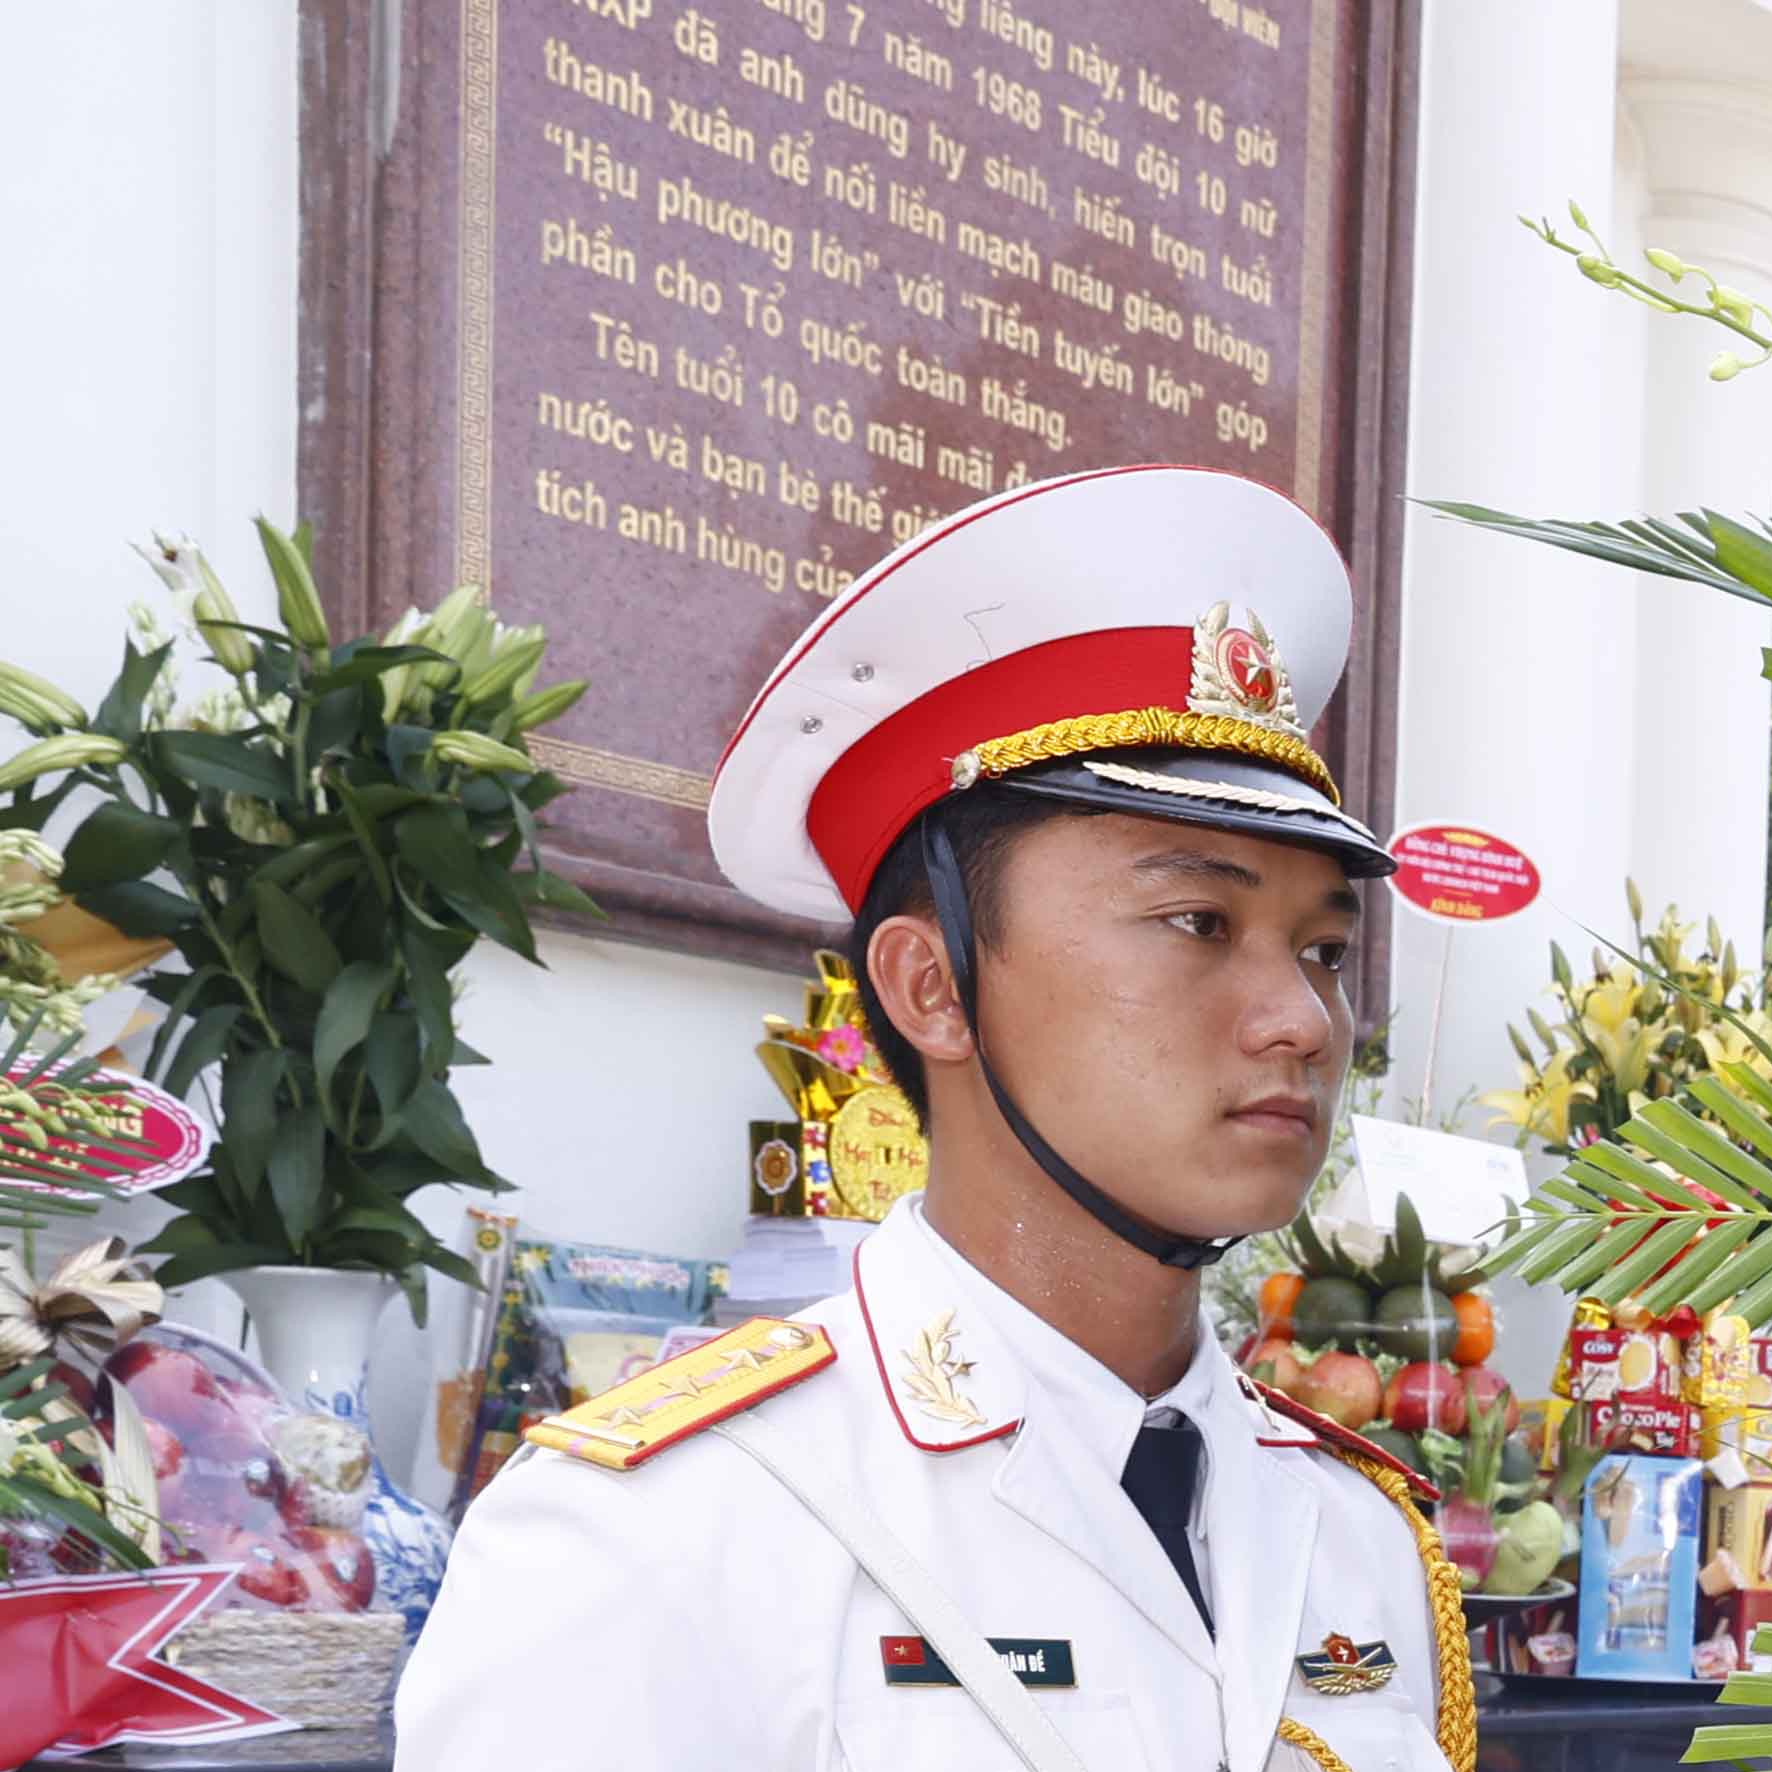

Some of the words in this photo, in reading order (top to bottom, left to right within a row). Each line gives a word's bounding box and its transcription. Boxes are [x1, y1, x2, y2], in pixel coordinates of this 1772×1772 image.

[543, 36, 653, 122] thanh
[667, 98, 756, 164] xuân
[769, 130, 815, 187] để
[825, 161, 877, 215] nối
[887, 182, 946, 246] liền
[957, 220, 1041, 283] mạch
[1051, 259, 1115, 313] máu
[1123, 290, 1185, 341] giao
[1192, 315, 1272, 386] thông
[674, 9, 720, 66] đã
[739, 47, 804, 104] anh
[825, 79, 909, 158] dũng
[928, 120, 966, 182] hy
[983, 154, 1057, 221] sinh,
[1074, 185, 1136, 249] hiến
[1150, 223, 1207, 281] trọn
[1221, 254, 1273, 306] tuổi
[846, 5, 866, 46] 7
[884, 32, 953, 92] năm
[972, 65, 1042, 131] 1968
[1058, 104, 1120, 168] Tiểu
[1136, 144, 1180, 200] đội
[1196, 170, 1226, 216] 10
[1241, 197, 1279, 239] nữ
[1067, 42, 1127, 101] này,
[1138, 68, 1181, 123] lúc
[1194, 98, 1225, 143] 16
[1235, 124, 1279, 169] giờ
[541, 217, 637, 286] phần
[654, 258, 723, 316] cho
[738, 281, 787, 338] Tổ
[800, 318, 884, 375] quốc
[896, 346, 967, 407] toàn
[980, 377, 1074, 453] thắng.
[589, 311, 660, 378] Tên
[674, 345, 745, 408] tuổi
[759, 373, 799, 425] 10
[812, 398, 854, 443] cô
[866, 420, 926, 470] mãi
[936, 443, 994, 493] mãi
[657, 176, 795, 273] phương
[896, 271, 947, 321] với
[1053, 329, 1136, 395] tuyến
[1215, 401, 1269, 452] góp
[534, 468, 608, 530] tích
[617, 504, 687, 554] anh
[696, 516, 787, 595] hùng
[537, 390, 634, 453] nước
[645, 423, 689, 473] và
[701, 435, 766, 500] bạn
[778, 460, 822, 513] bè
[830, 482, 888, 533] thế
